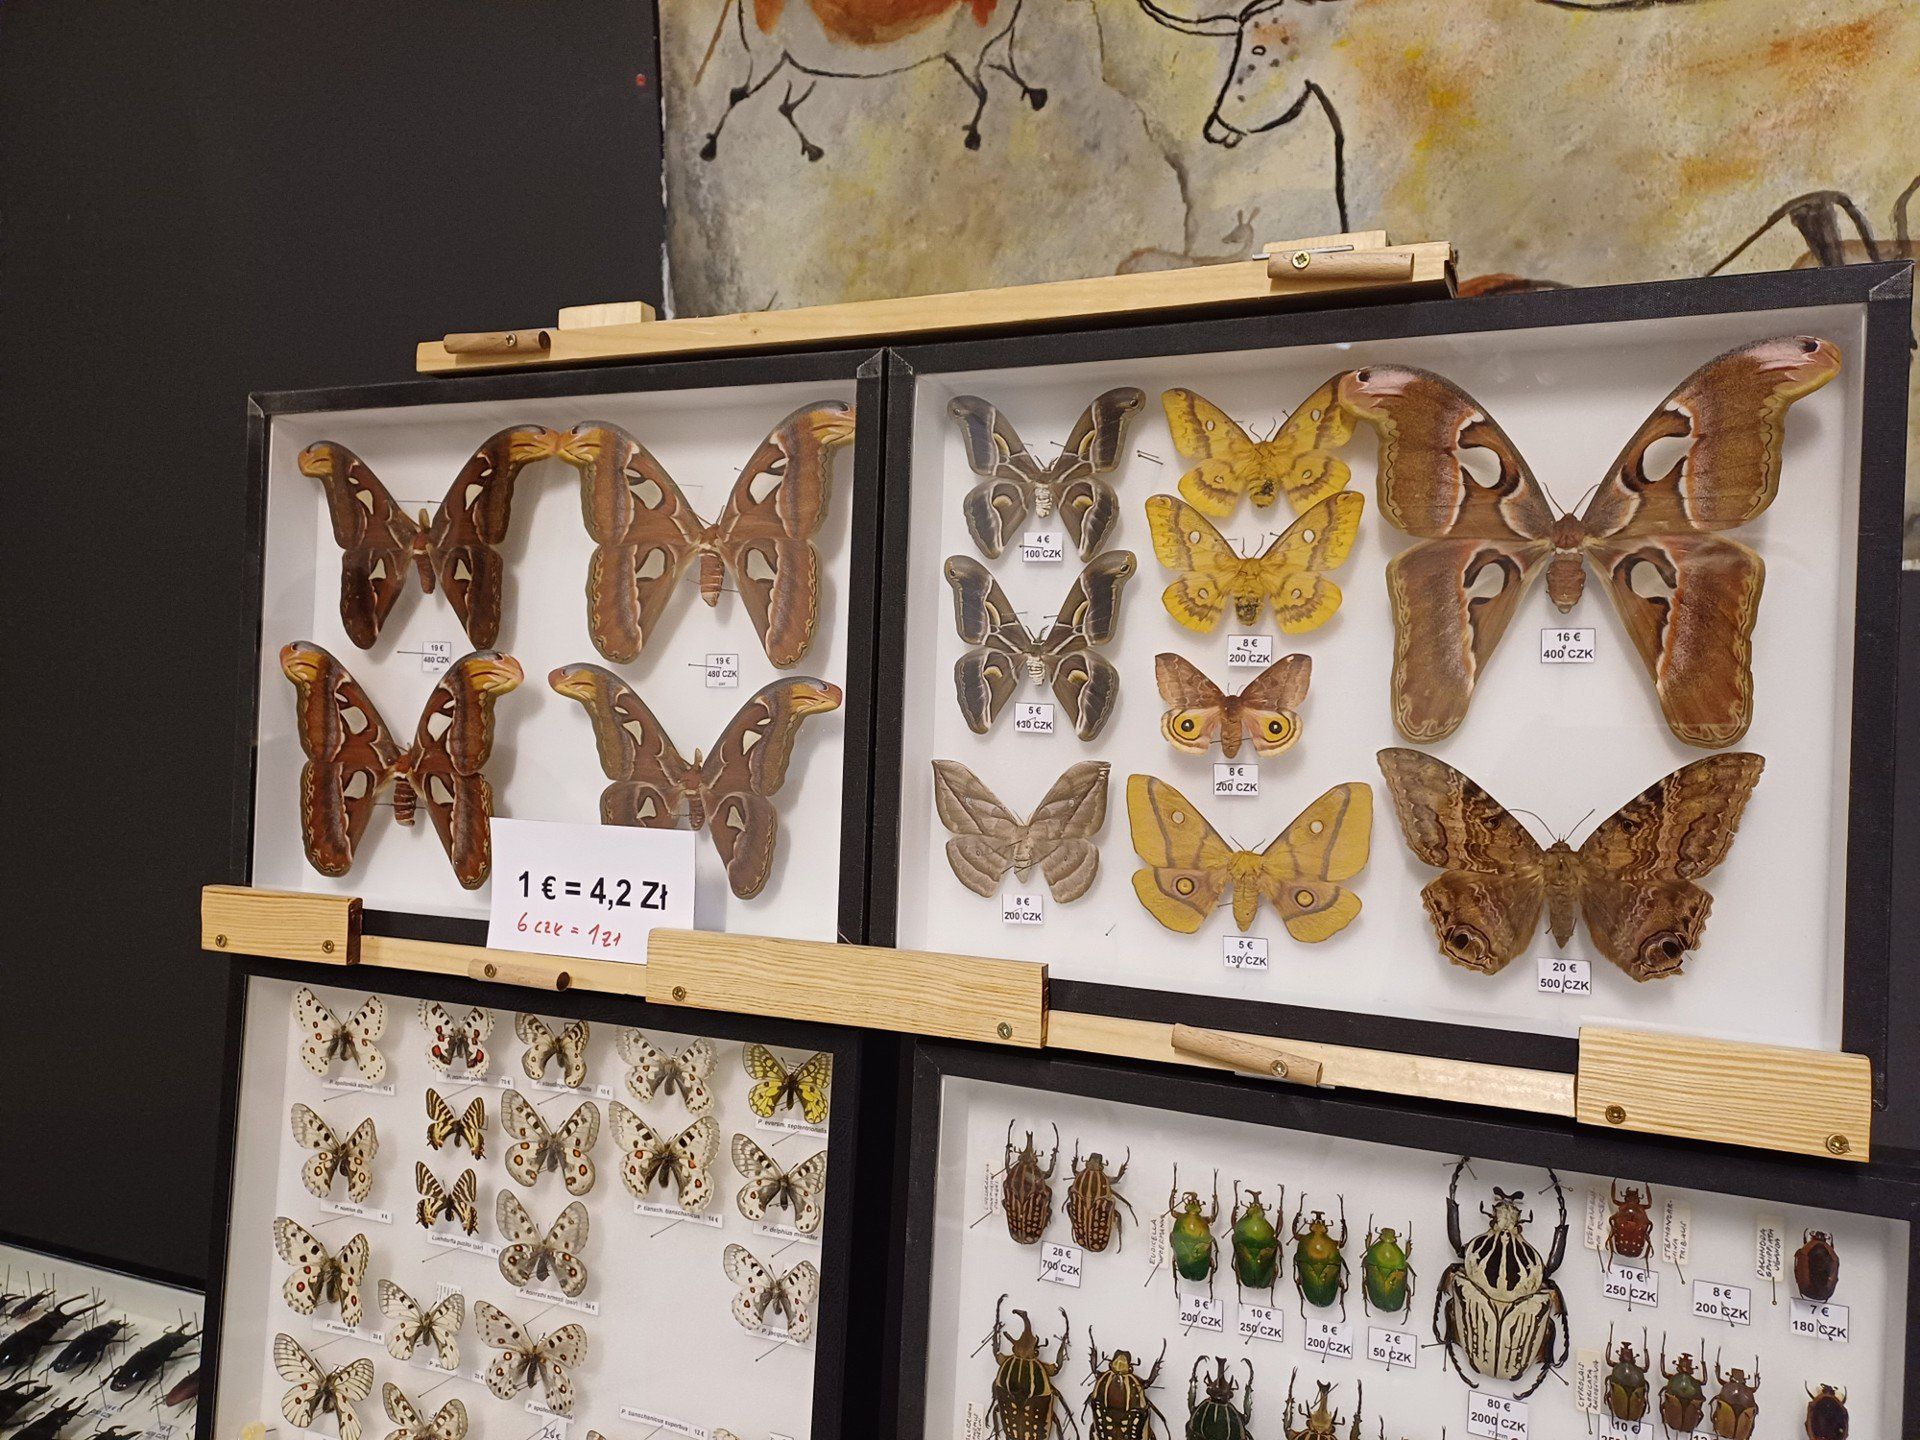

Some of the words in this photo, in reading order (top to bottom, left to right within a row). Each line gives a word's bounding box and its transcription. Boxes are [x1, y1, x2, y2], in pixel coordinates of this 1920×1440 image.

[1036, 535, 1043, 543] 4
[1044, 535, 1050, 543] €
[1025, 550, 1041, 558] 100
[1042, 550, 1061, 559] CZK
[1556, 632, 1571, 642] 16
[1573, 633, 1581, 642] €
[439, 644, 444, 652] €
[1243, 639, 1249, 647] 8
[1251, 639, 1258, 648] €
[1229, 654, 1246, 663] 200
[1249, 654, 1270, 664] CZK
[1543, 649, 1564, 659] 400
[1567, 649, 1593, 659] CZK
[436, 656, 450, 664] CZK
[716, 657, 724, 665] 19
[725, 657, 731, 665] €
[722, 670, 737, 678] CZK
[1028, 707, 1034, 715] 5
[1035, 707, 1041, 715] €
[1033, 720, 1053, 731] CZK
[1229, 767, 1236, 776] 8
[1237, 767, 1244, 776] €
[1216, 782, 1234, 792] 200
[1236, 782, 1258, 792] CZK
[519, 871, 529, 898] 1
[541, 876, 556, 900] €
[565, 881, 581, 896] =
[590, 877, 632, 911] 4,2
[641, 882, 668, 911] Zł
[1016, 897, 1022, 906] 8
[1023, 898, 1030, 906] €
[1004, 911, 1020, 920] 200
[1022, 912, 1042, 922] CZK
[517, 912, 528, 933] 6
[1238, 941, 1244, 949] 5
[1246, 941, 1253, 950] €
[1225, 955, 1242, 965] 130
[1245, 956, 1267, 967] CZK
[1553, 962, 1566, 972] 20
[1569, 963, 1577, 973] €
[1540, 978, 1561, 989] 500
[1564, 979, 1589, 990] CZK
[1053, 1246, 1064, 1257] 28
[1065, 1250, 1071, 1259] €
[1042, 1260, 1058, 1271] 700
[1060, 1263, 1080, 1276] CZK
[1620, 1270, 1633, 1281] 10
[1636, 1272, 1645, 1283] €
[1605, 1283, 1626, 1296] 250
[1630, 1287, 1656, 1302] CZK
[1713, 1287, 1719, 1297] 8
[1724, 1289, 1732, 1300] €
[1195, 1299, 1201, 1308] 8
[1202, 1300, 1209, 1310] €
[1252, 1309, 1263, 1318] 10
[1264, 1311, 1272, 1320] €
[1695, 1302, 1717, 1314] 200
[1721, 1305, 1748, 1320] CZK
[1810, 1305, 1816, 1315] 7
[1821, 1307, 1830, 1317] €
[1181, 1312, 1199, 1323] 200
[1200, 1315, 1221, 1328] CZK
[1240, 1322, 1258, 1334] 250
[1259, 1325, 1282, 1338] CZK
[1322, 1324, 1328, 1334] 8
[1330, 1326, 1338, 1336] €
[1792, 1320, 1814, 1333] 180
[1818, 1324, 1847, 1339] CZK
[1385, 1333, 1392, 1343] 2
[1393, 1335, 1401, 1345] €
[1307, 1337, 1325, 1349] 200
[1328, 1341, 1351, 1355] CZK
[1373, 1347, 1386, 1359] 50
[1389, 1350, 1412, 1363] CZK
[1487, 1398, 1500, 1409] 80
[1503, 1402, 1511, 1413] €
[1471, 1411, 1498, 1426] 2000
[1500, 1419, 1526, 1433] CZK
[1615, 1422, 1628, 1432] 10
